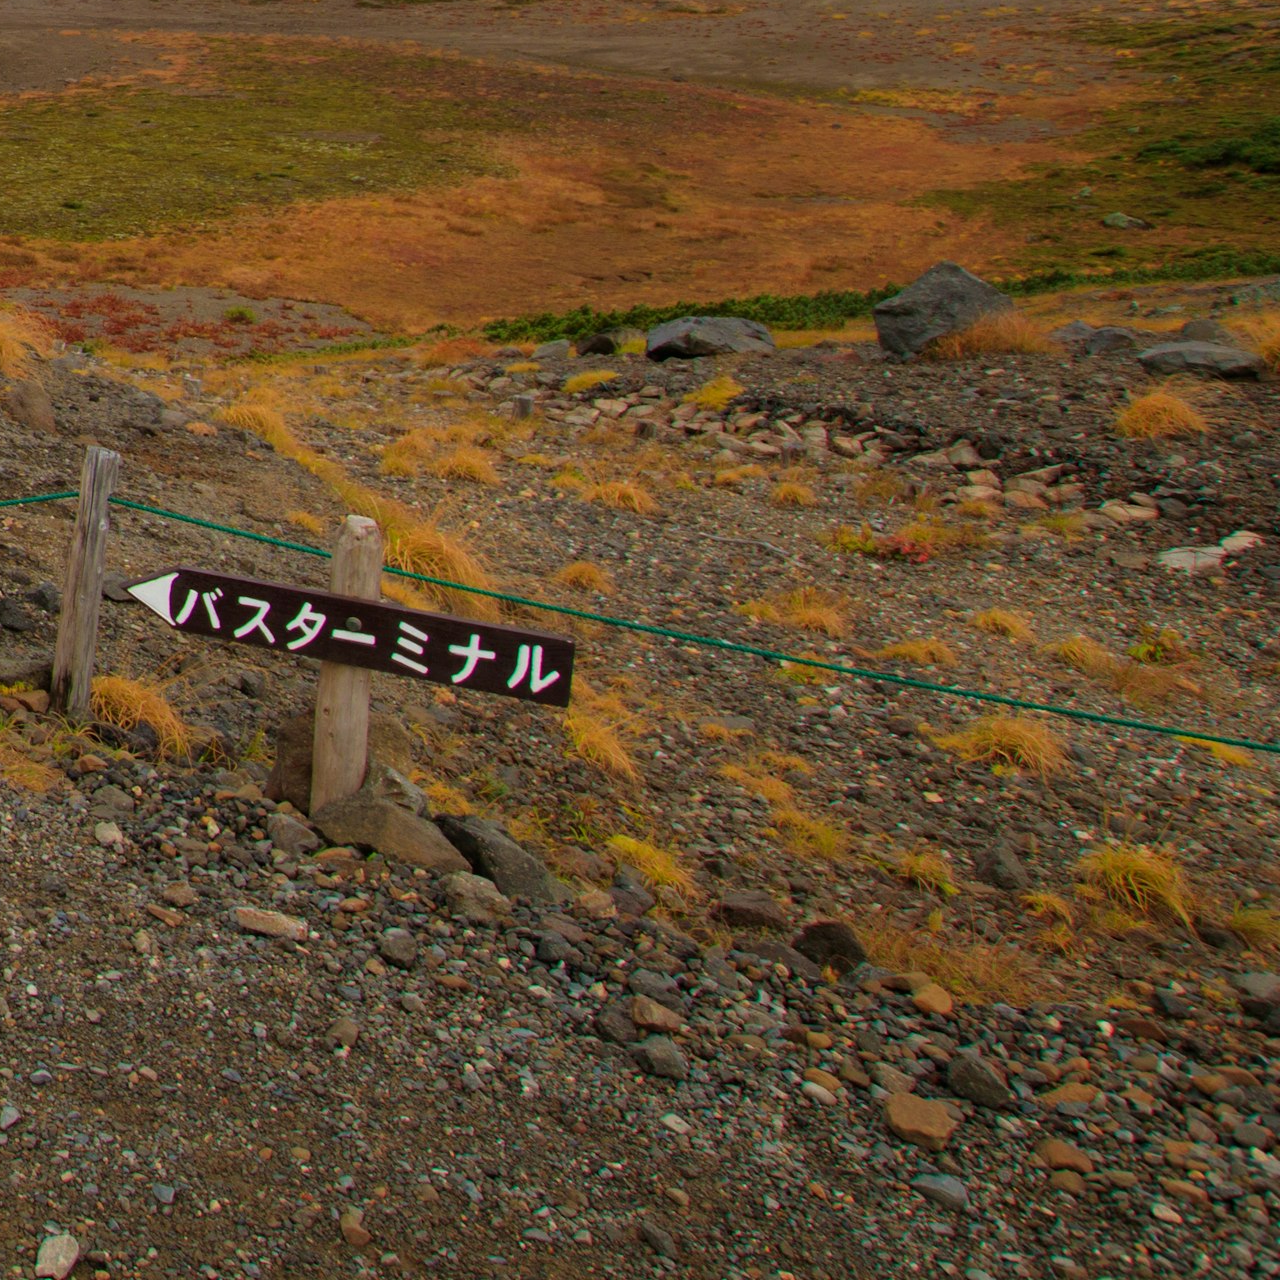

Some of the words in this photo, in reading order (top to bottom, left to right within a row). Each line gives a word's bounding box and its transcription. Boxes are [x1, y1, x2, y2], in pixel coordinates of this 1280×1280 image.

[176, 588, 561, 694] バスターミナル
